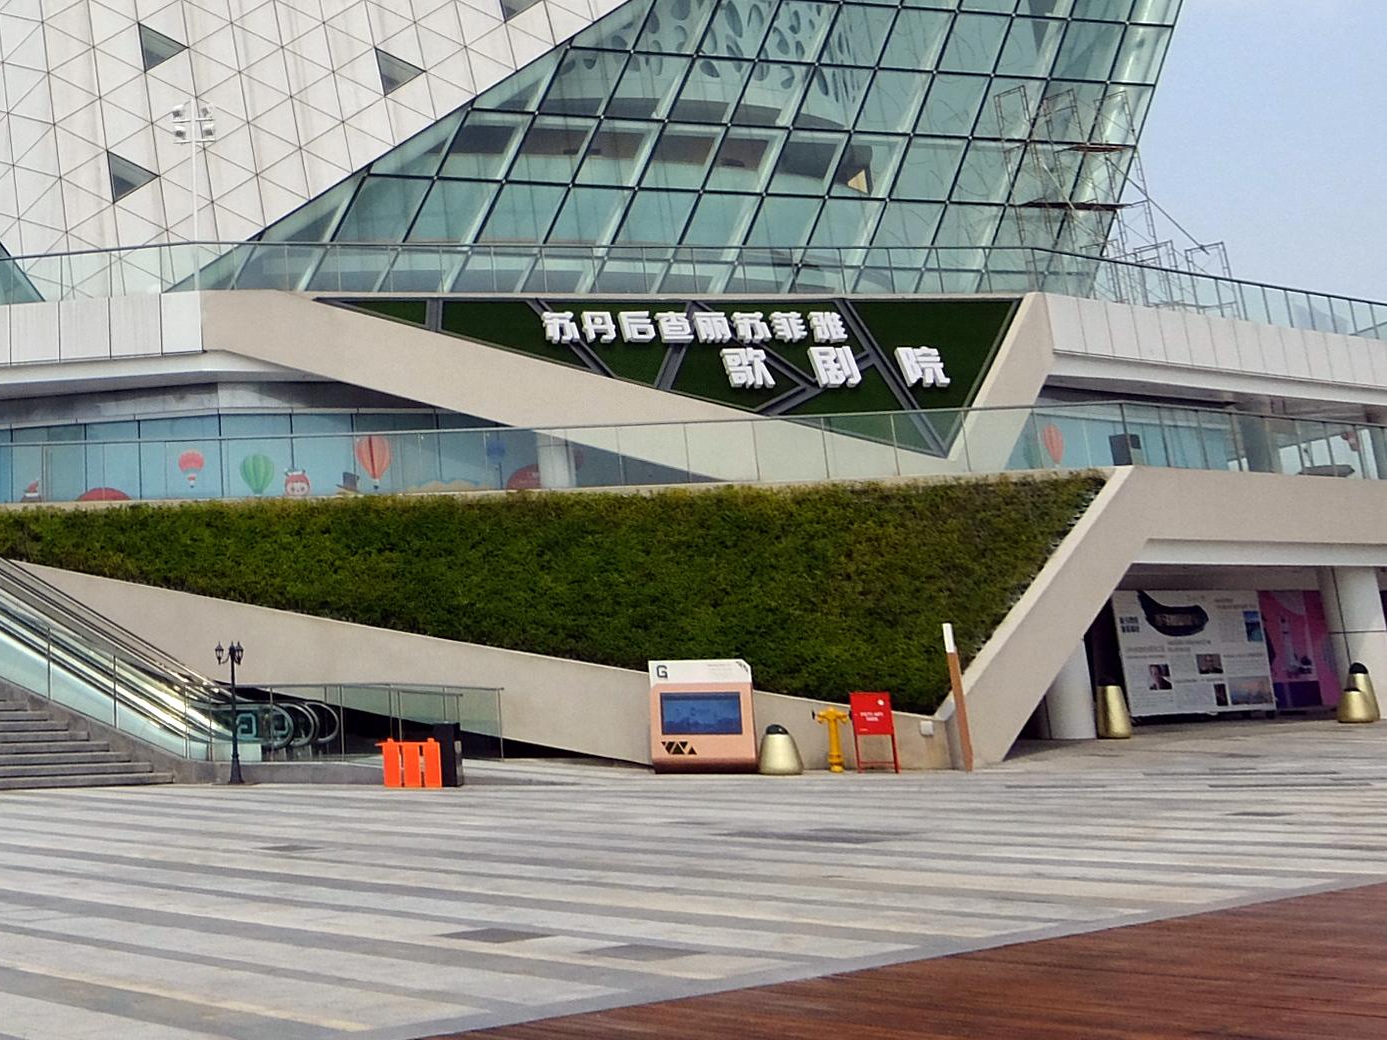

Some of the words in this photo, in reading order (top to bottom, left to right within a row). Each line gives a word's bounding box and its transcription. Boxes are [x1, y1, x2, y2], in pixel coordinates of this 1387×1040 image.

[541, 310, 848, 344] 苏丹后查丽苏菲雅
[720, 346, 952, 389] 歌剧院
[656, 664, 668, 679] G
